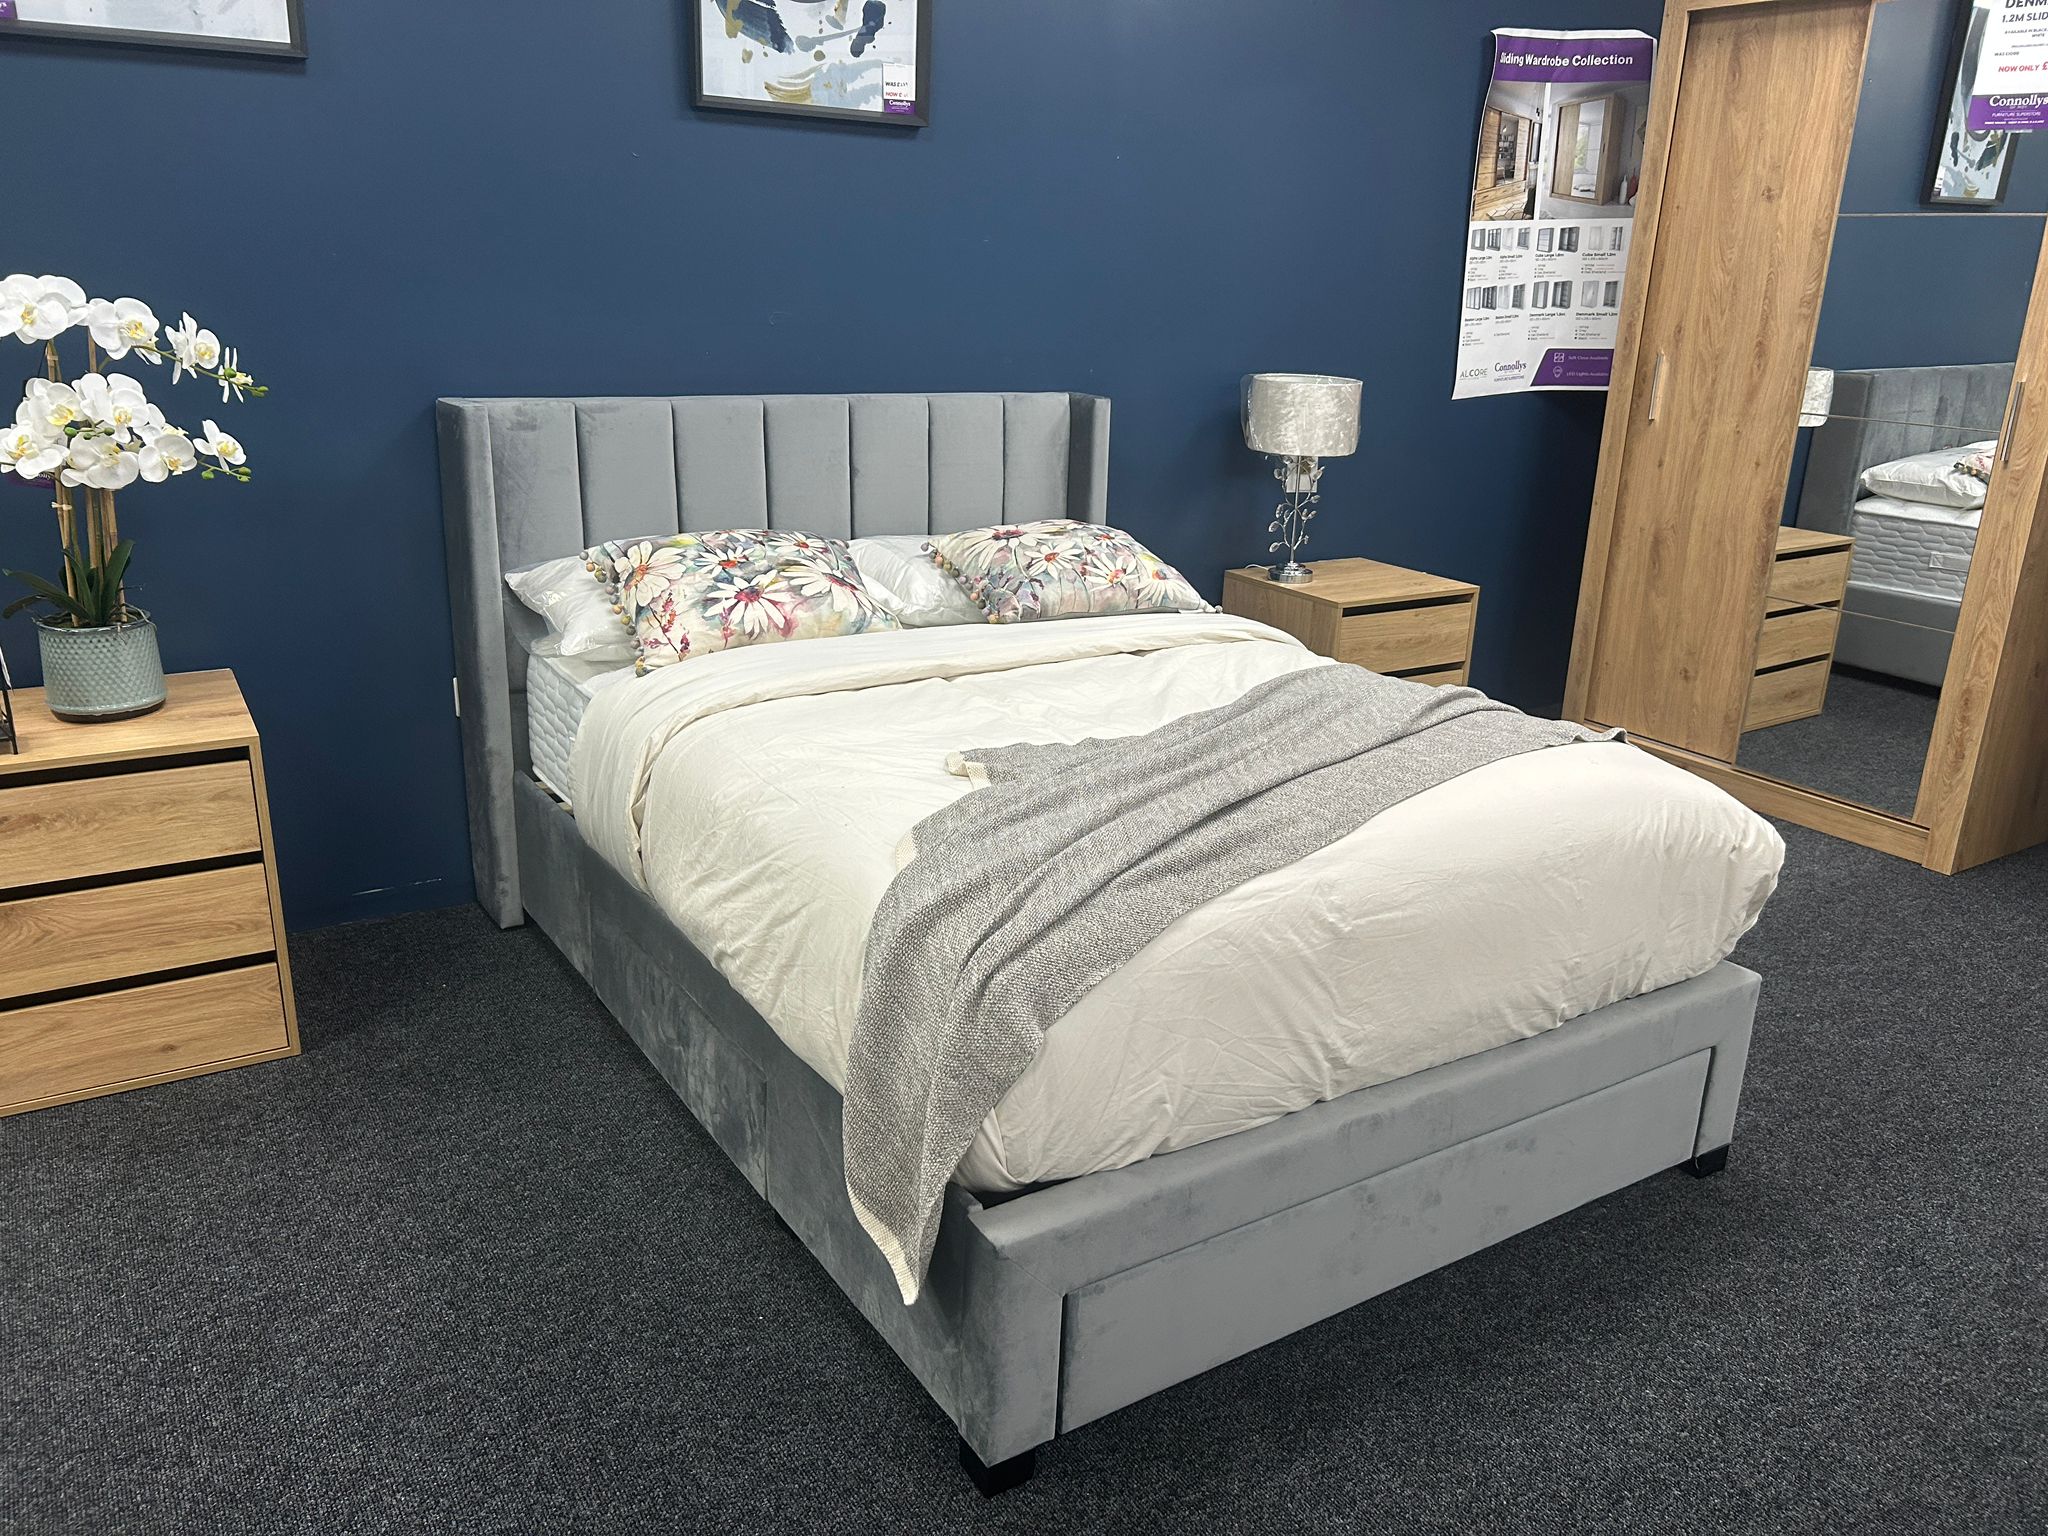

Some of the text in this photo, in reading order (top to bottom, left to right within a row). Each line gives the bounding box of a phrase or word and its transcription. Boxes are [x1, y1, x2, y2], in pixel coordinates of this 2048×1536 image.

[2005, 0, 2048, 8] DENM
[2002, 13, 2025, 23] 1.2M
[1525, 54, 1569, 67] Wardrobe
[1572, 54, 1633, 67] Collection
[2019, 64, 2040, 72] ONLY
[1989, 94, 2048, 109] Connollys
[1494, 360, 1527, 373] Connollys
[1460, 368, 1488, 379] ALCORE
